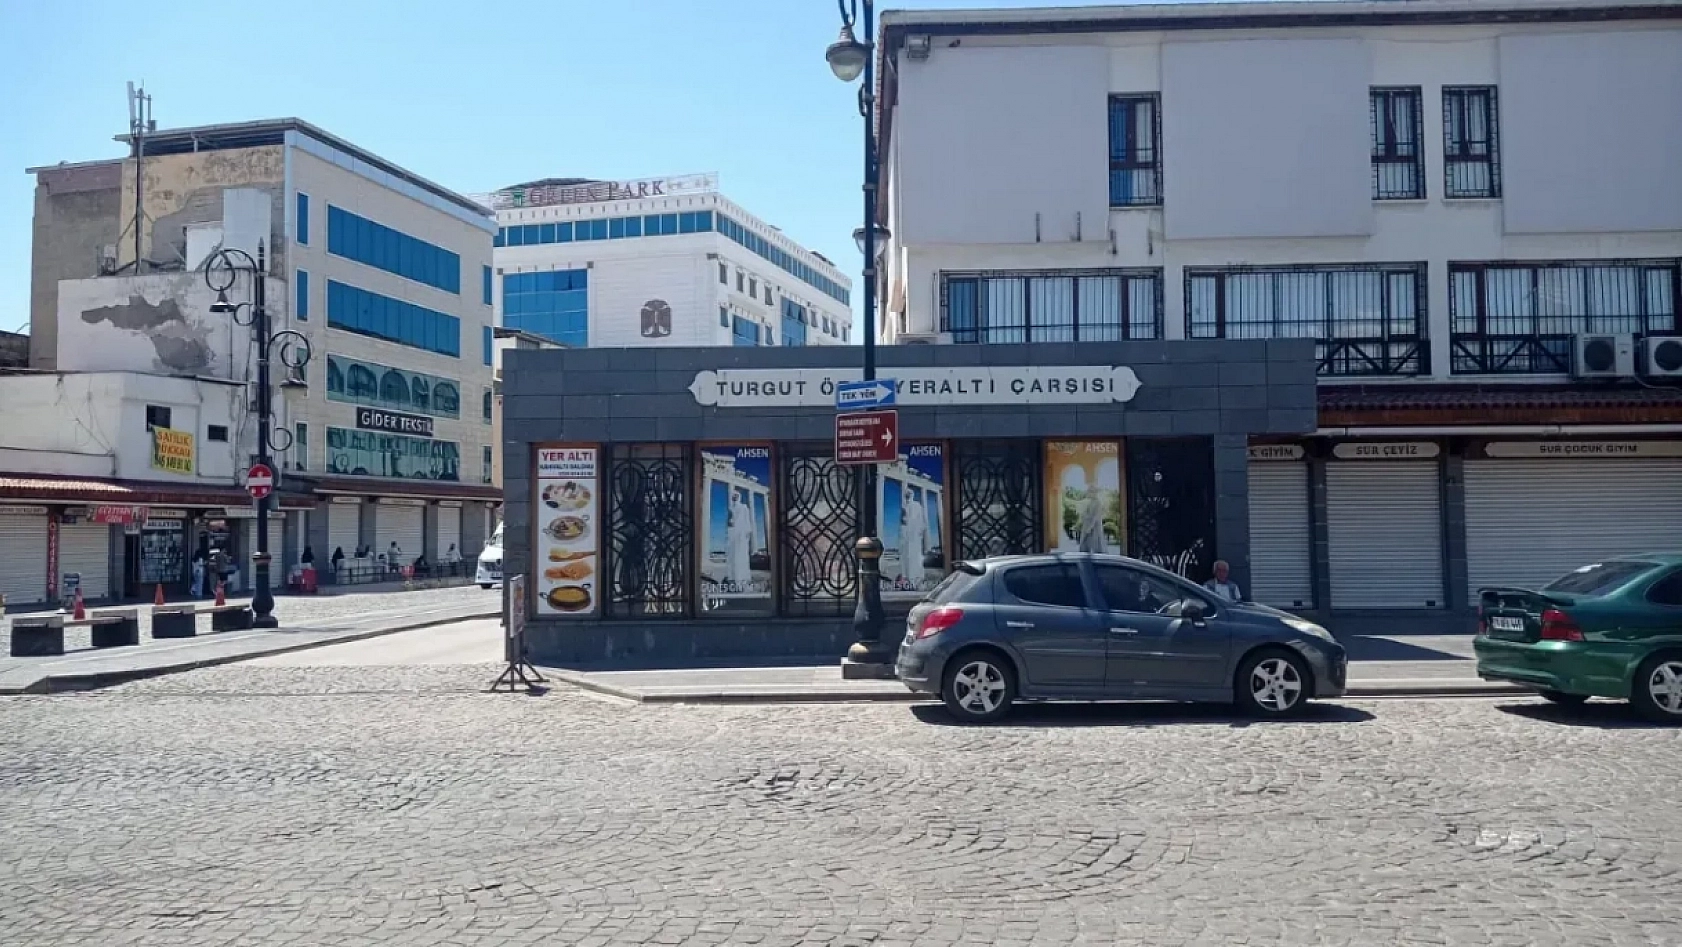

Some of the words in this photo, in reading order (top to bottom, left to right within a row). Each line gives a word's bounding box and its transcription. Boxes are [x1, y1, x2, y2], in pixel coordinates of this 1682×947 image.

[530, 185, 599, 205] GREEN
[607, 180, 663, 200] PARK
[716, 380, 807, 396] TURGUT
[895, 378, 995, 394] YERALTI
[1010, 378, 1114, 395] ÇARŞISI
[841, 390, 857, 400] TEK
[860, 388, 877, 398] YÖN
[361, 409, 397, 429] GİDER
[737, 448, 769, 459] AHSEN
[910, 446, 942, 456] AHSEN
[1085, 442, 1118, 454] AHSEN
[1261, 446, 1294, 458] GİYİM
[1356, 445, 1379, 455] SUR
[1383, 445, 1419, 457] ÇEYİZ
[1540, 445, 1562, 454] SUR
[1565, 445, 1603, 455] ÇOCUK
[542, 452, 565, 461] YER
[568, 451, 592, 461] ALTI
